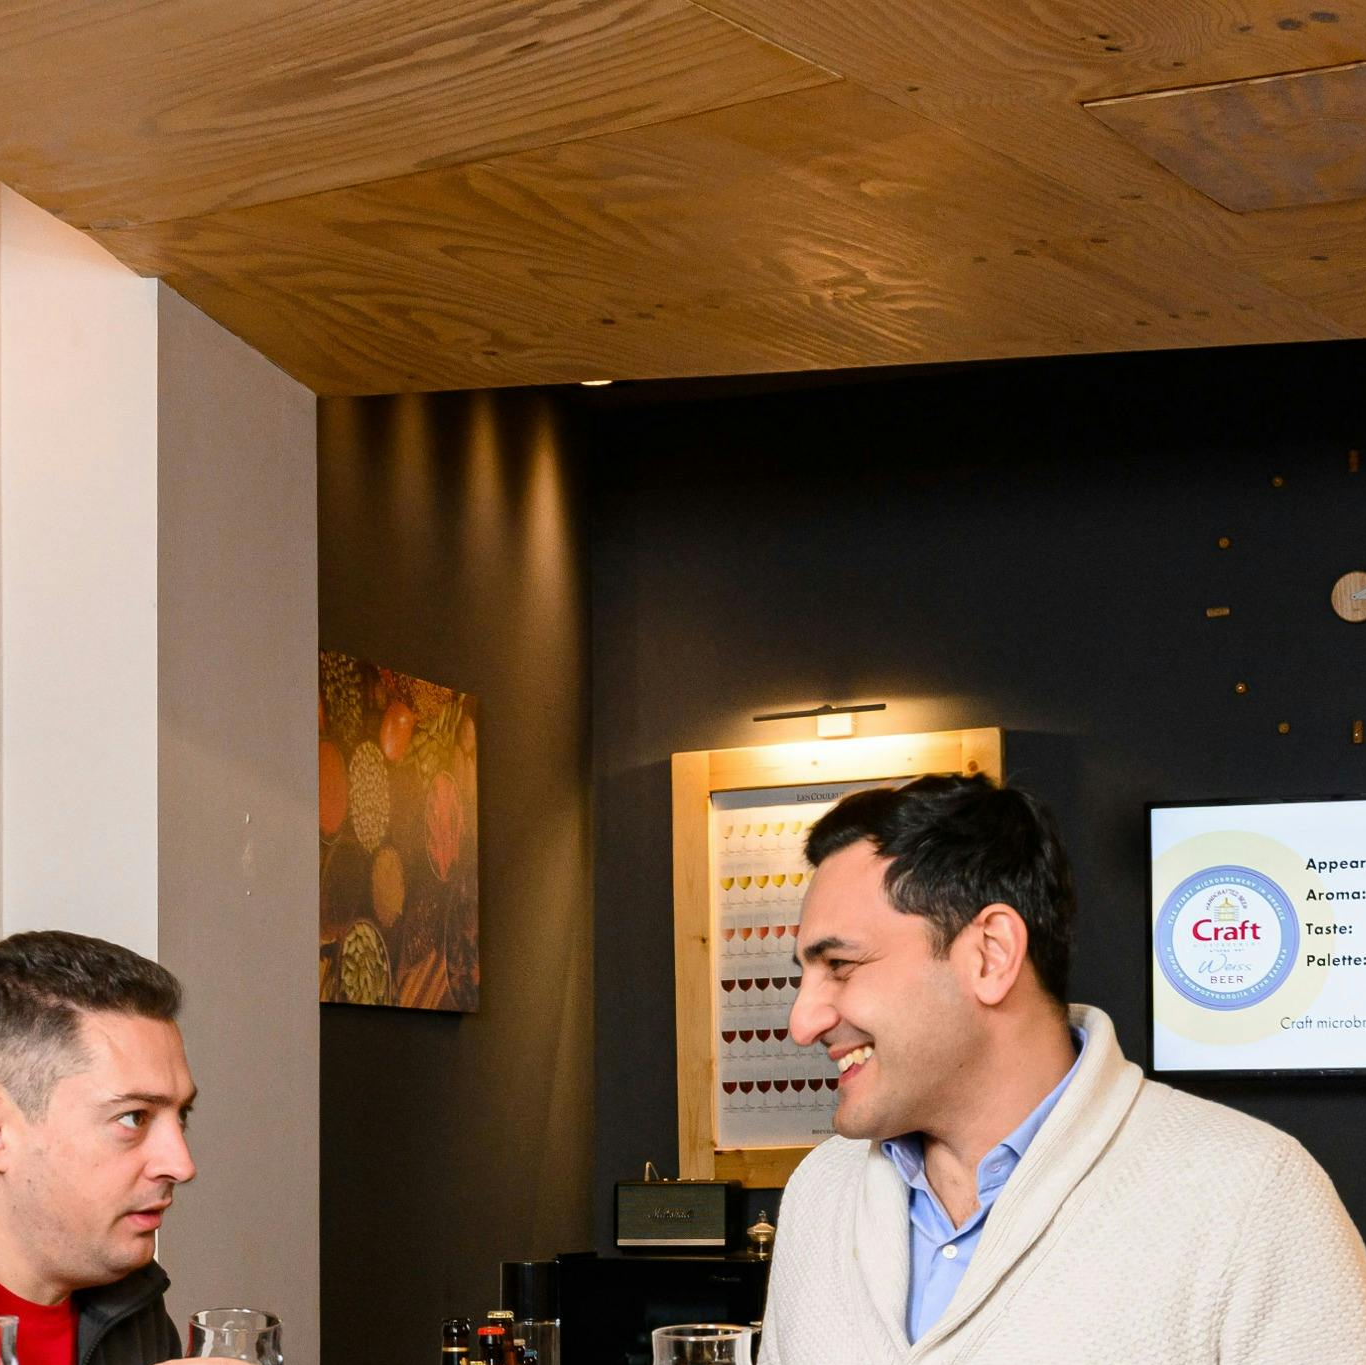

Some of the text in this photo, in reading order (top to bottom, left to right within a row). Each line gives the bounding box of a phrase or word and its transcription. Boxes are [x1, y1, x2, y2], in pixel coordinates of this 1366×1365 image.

[1306, 889, 1365, 901] Aroma:
[1192, 919, 1261, 941] Craft
[1306, 923, 1353, 935] Taste:
[1306, 953, 1366, 967] Palette:
[1210, 975, 1244, 984] BEER
[1280, 1016, 1312, 1030] Craft
